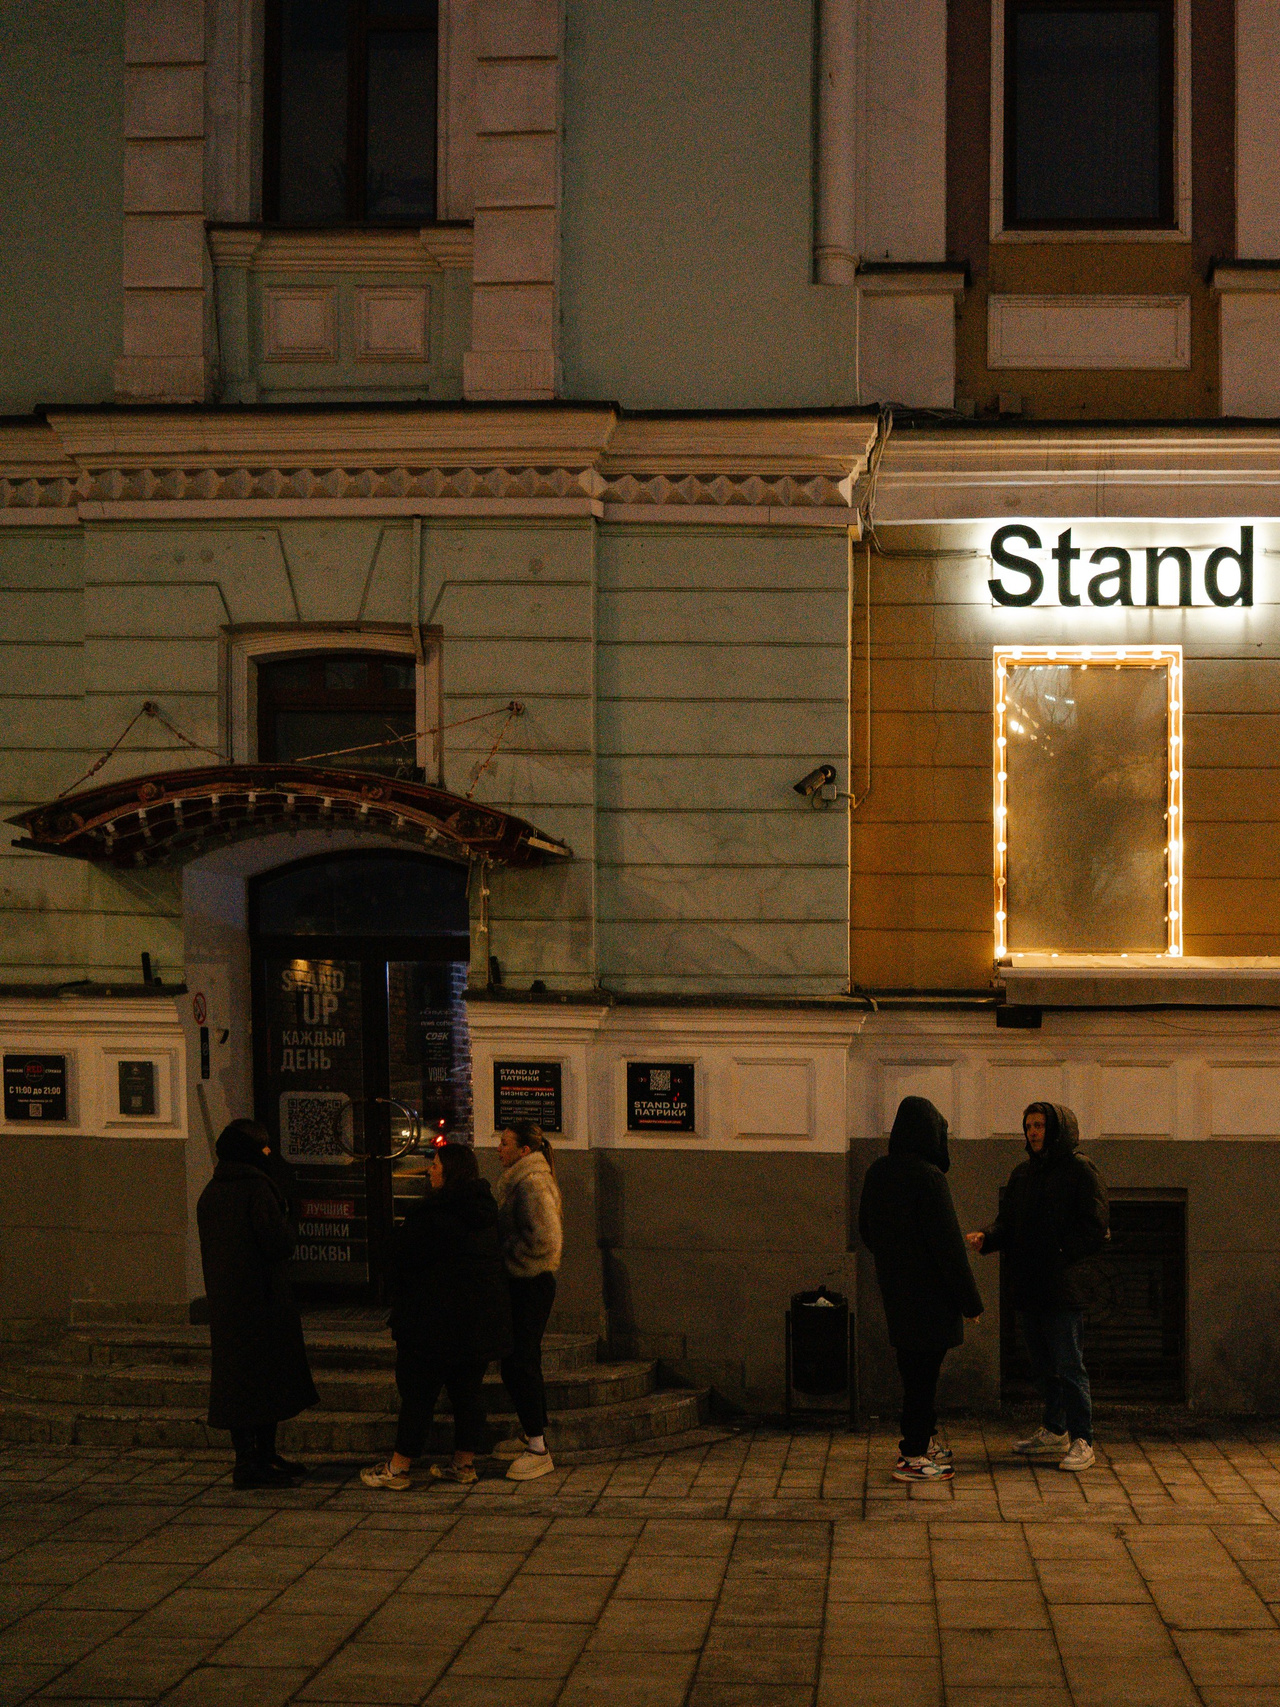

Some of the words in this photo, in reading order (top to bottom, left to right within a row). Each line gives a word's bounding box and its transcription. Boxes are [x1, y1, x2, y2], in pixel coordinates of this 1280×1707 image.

[987, 524, 1254, 607] Stand
[303, 993, 339, 1025] UP
[282, 1028, 346, 1047] КАЖДЫЙ
[280, 1048, 332, 1072] ДЕНЬ
[500, 1068, 528, 1076] STAND
[15, 1086, 32, 1094] 11:00
[32, 1087, 42, 1096] до
[43, 1086, 61, 1095] 21:00
[633, 1101, 671, 1109] STAND
[634, 1109, 687, 1117] ПАТРИКИ
[299, 1222, 349, 1237] КОМИКИ
